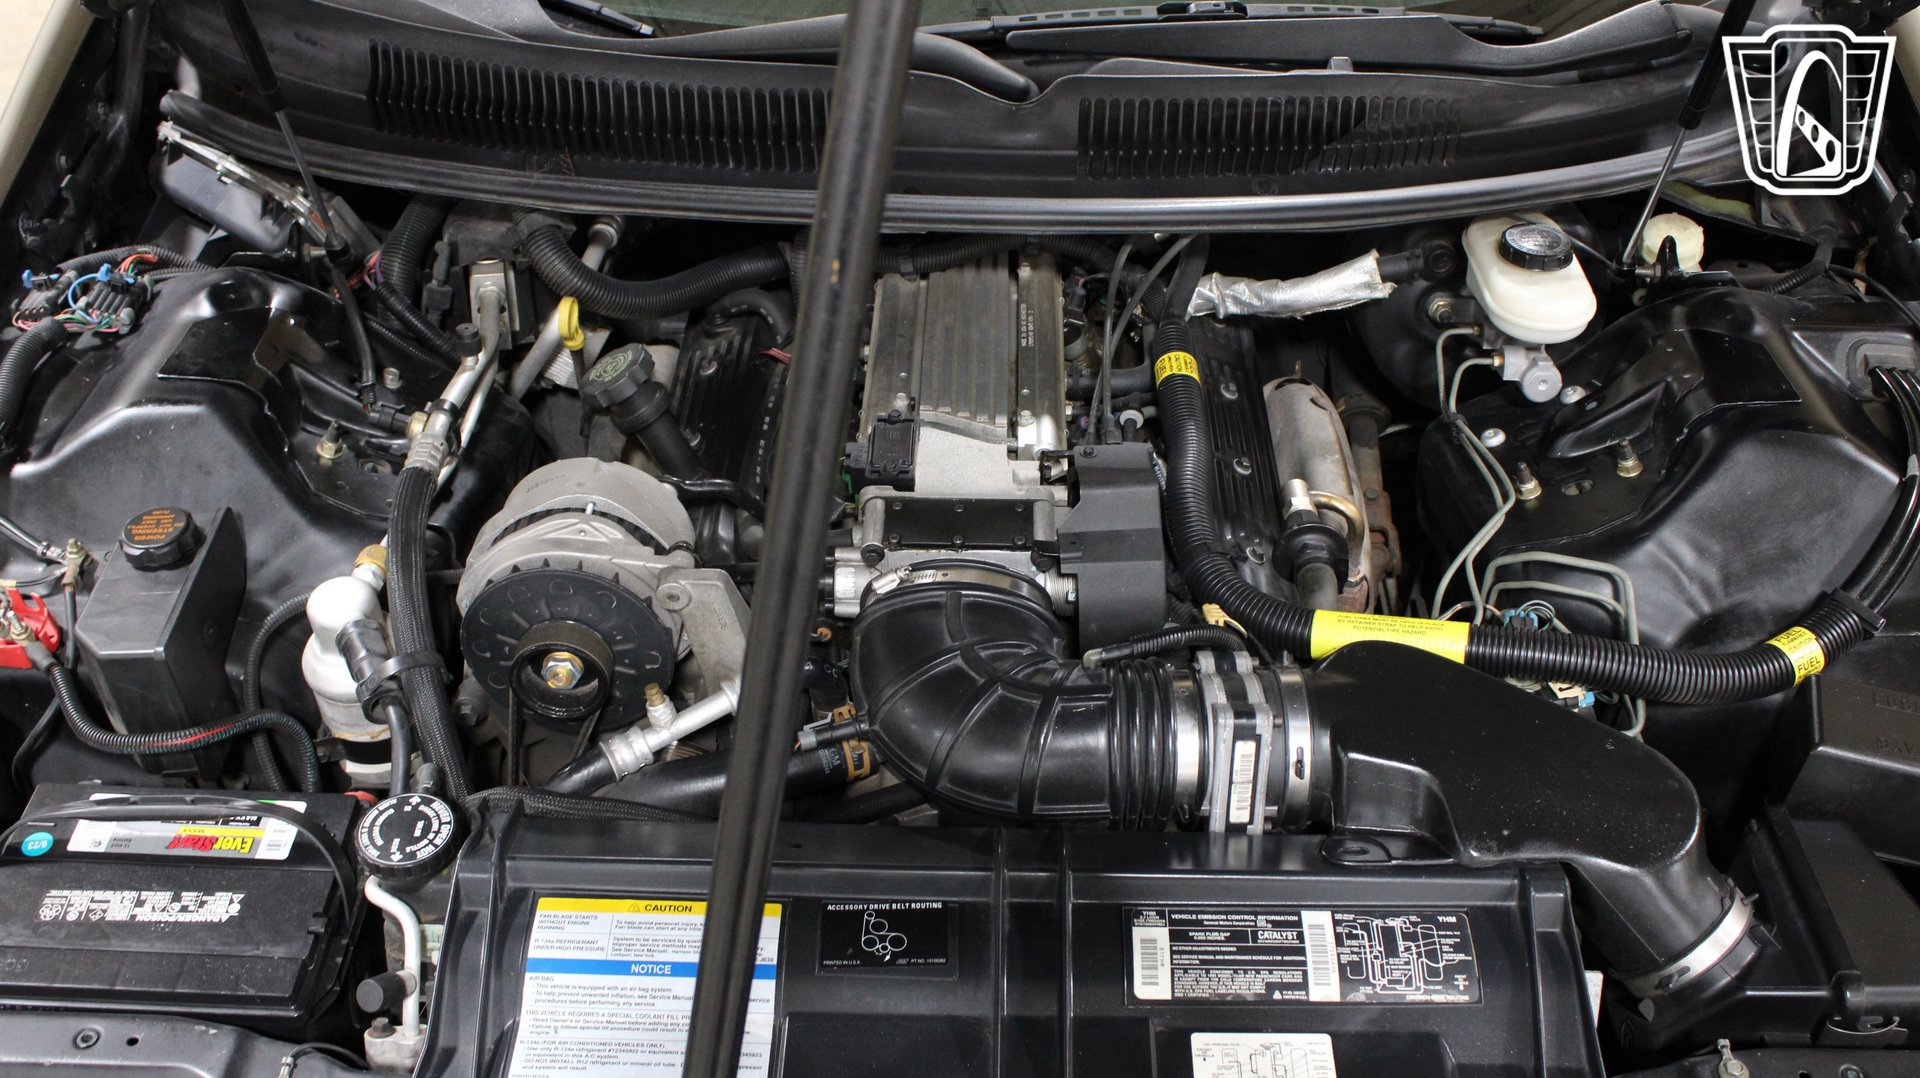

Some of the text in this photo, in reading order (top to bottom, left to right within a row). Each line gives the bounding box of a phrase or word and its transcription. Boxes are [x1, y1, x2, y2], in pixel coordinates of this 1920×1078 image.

[1774, 629, 1802, 642] FUEL
[1788, 637, 1813, 652] CAUTION
[1798, 656, 1821, 673] FUEL
[830, 748, 840, 766] GM
[430, 800, 451, 823] NEVER
[433, 824, 450, 846] OPEN
[28, 840, 47, 850] 9/23
[166, 835, 255, 854] EverStart
[416, 844, 436, 859] HOT
[644, 904, 692, 912] CAUTION
[135, 914, 220, 922] DANGER/POISON
[1258, 931, 1297, 940] CATALYST
[631, 964, 672, 974] NOTICE
